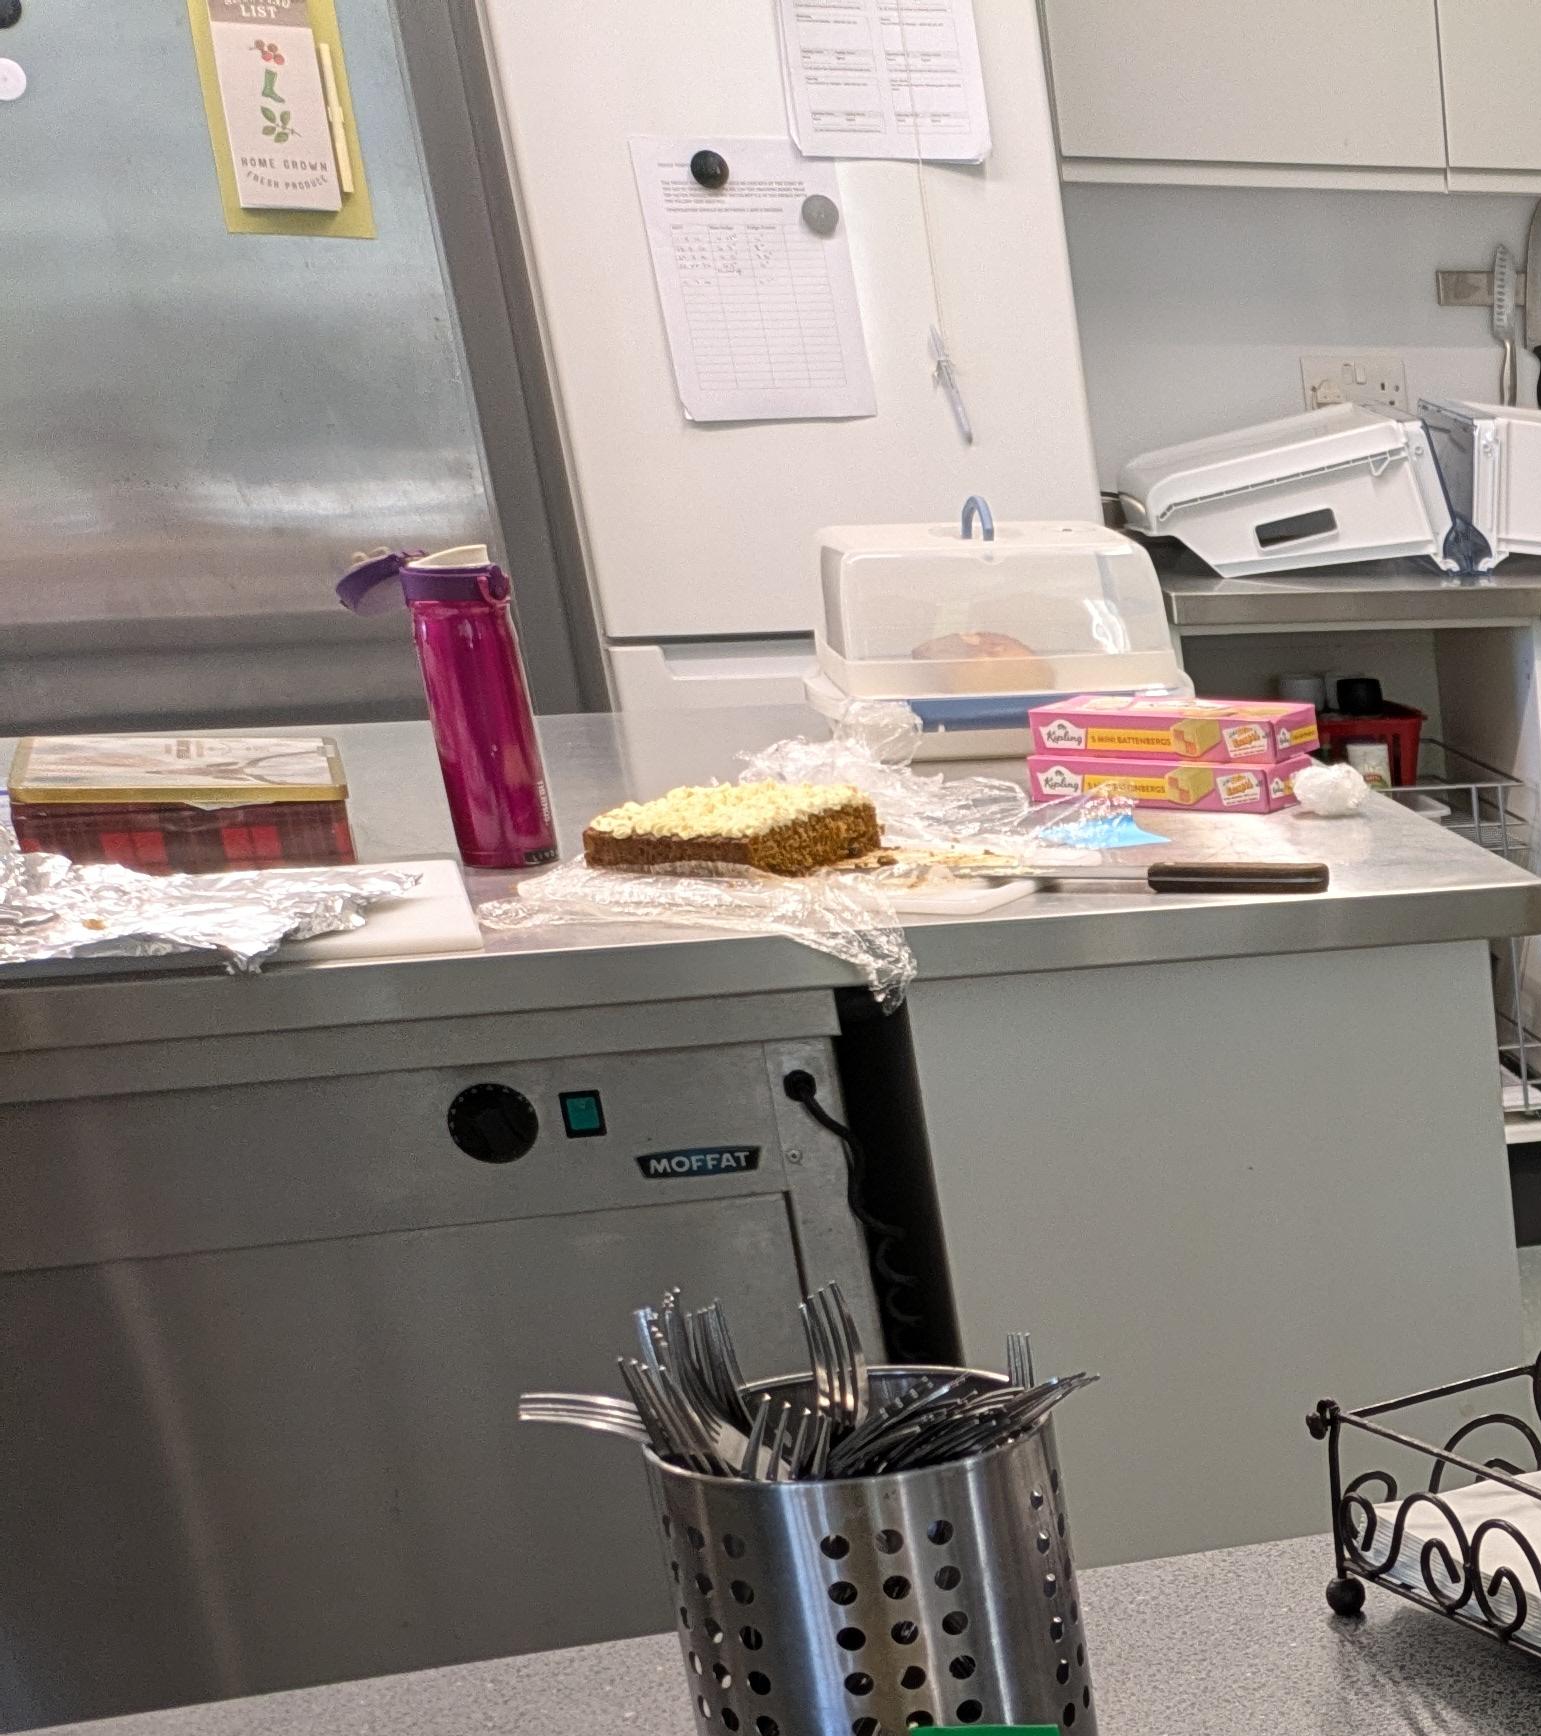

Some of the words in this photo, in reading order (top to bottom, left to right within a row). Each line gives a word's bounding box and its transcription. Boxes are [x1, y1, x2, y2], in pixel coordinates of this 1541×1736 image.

[239, 4, 278, 19] LIST
[240, 156, 276, 169] HOME
[283, 159, 328, 172] GROWN
[1046, 729, 1083, 747] Kipling
[1117, 736, 1172, 747] BATTENBERGS
[1044, 776, 1079, 793] Kipling
[649, 1151, 750, 1175] MOFFAT
